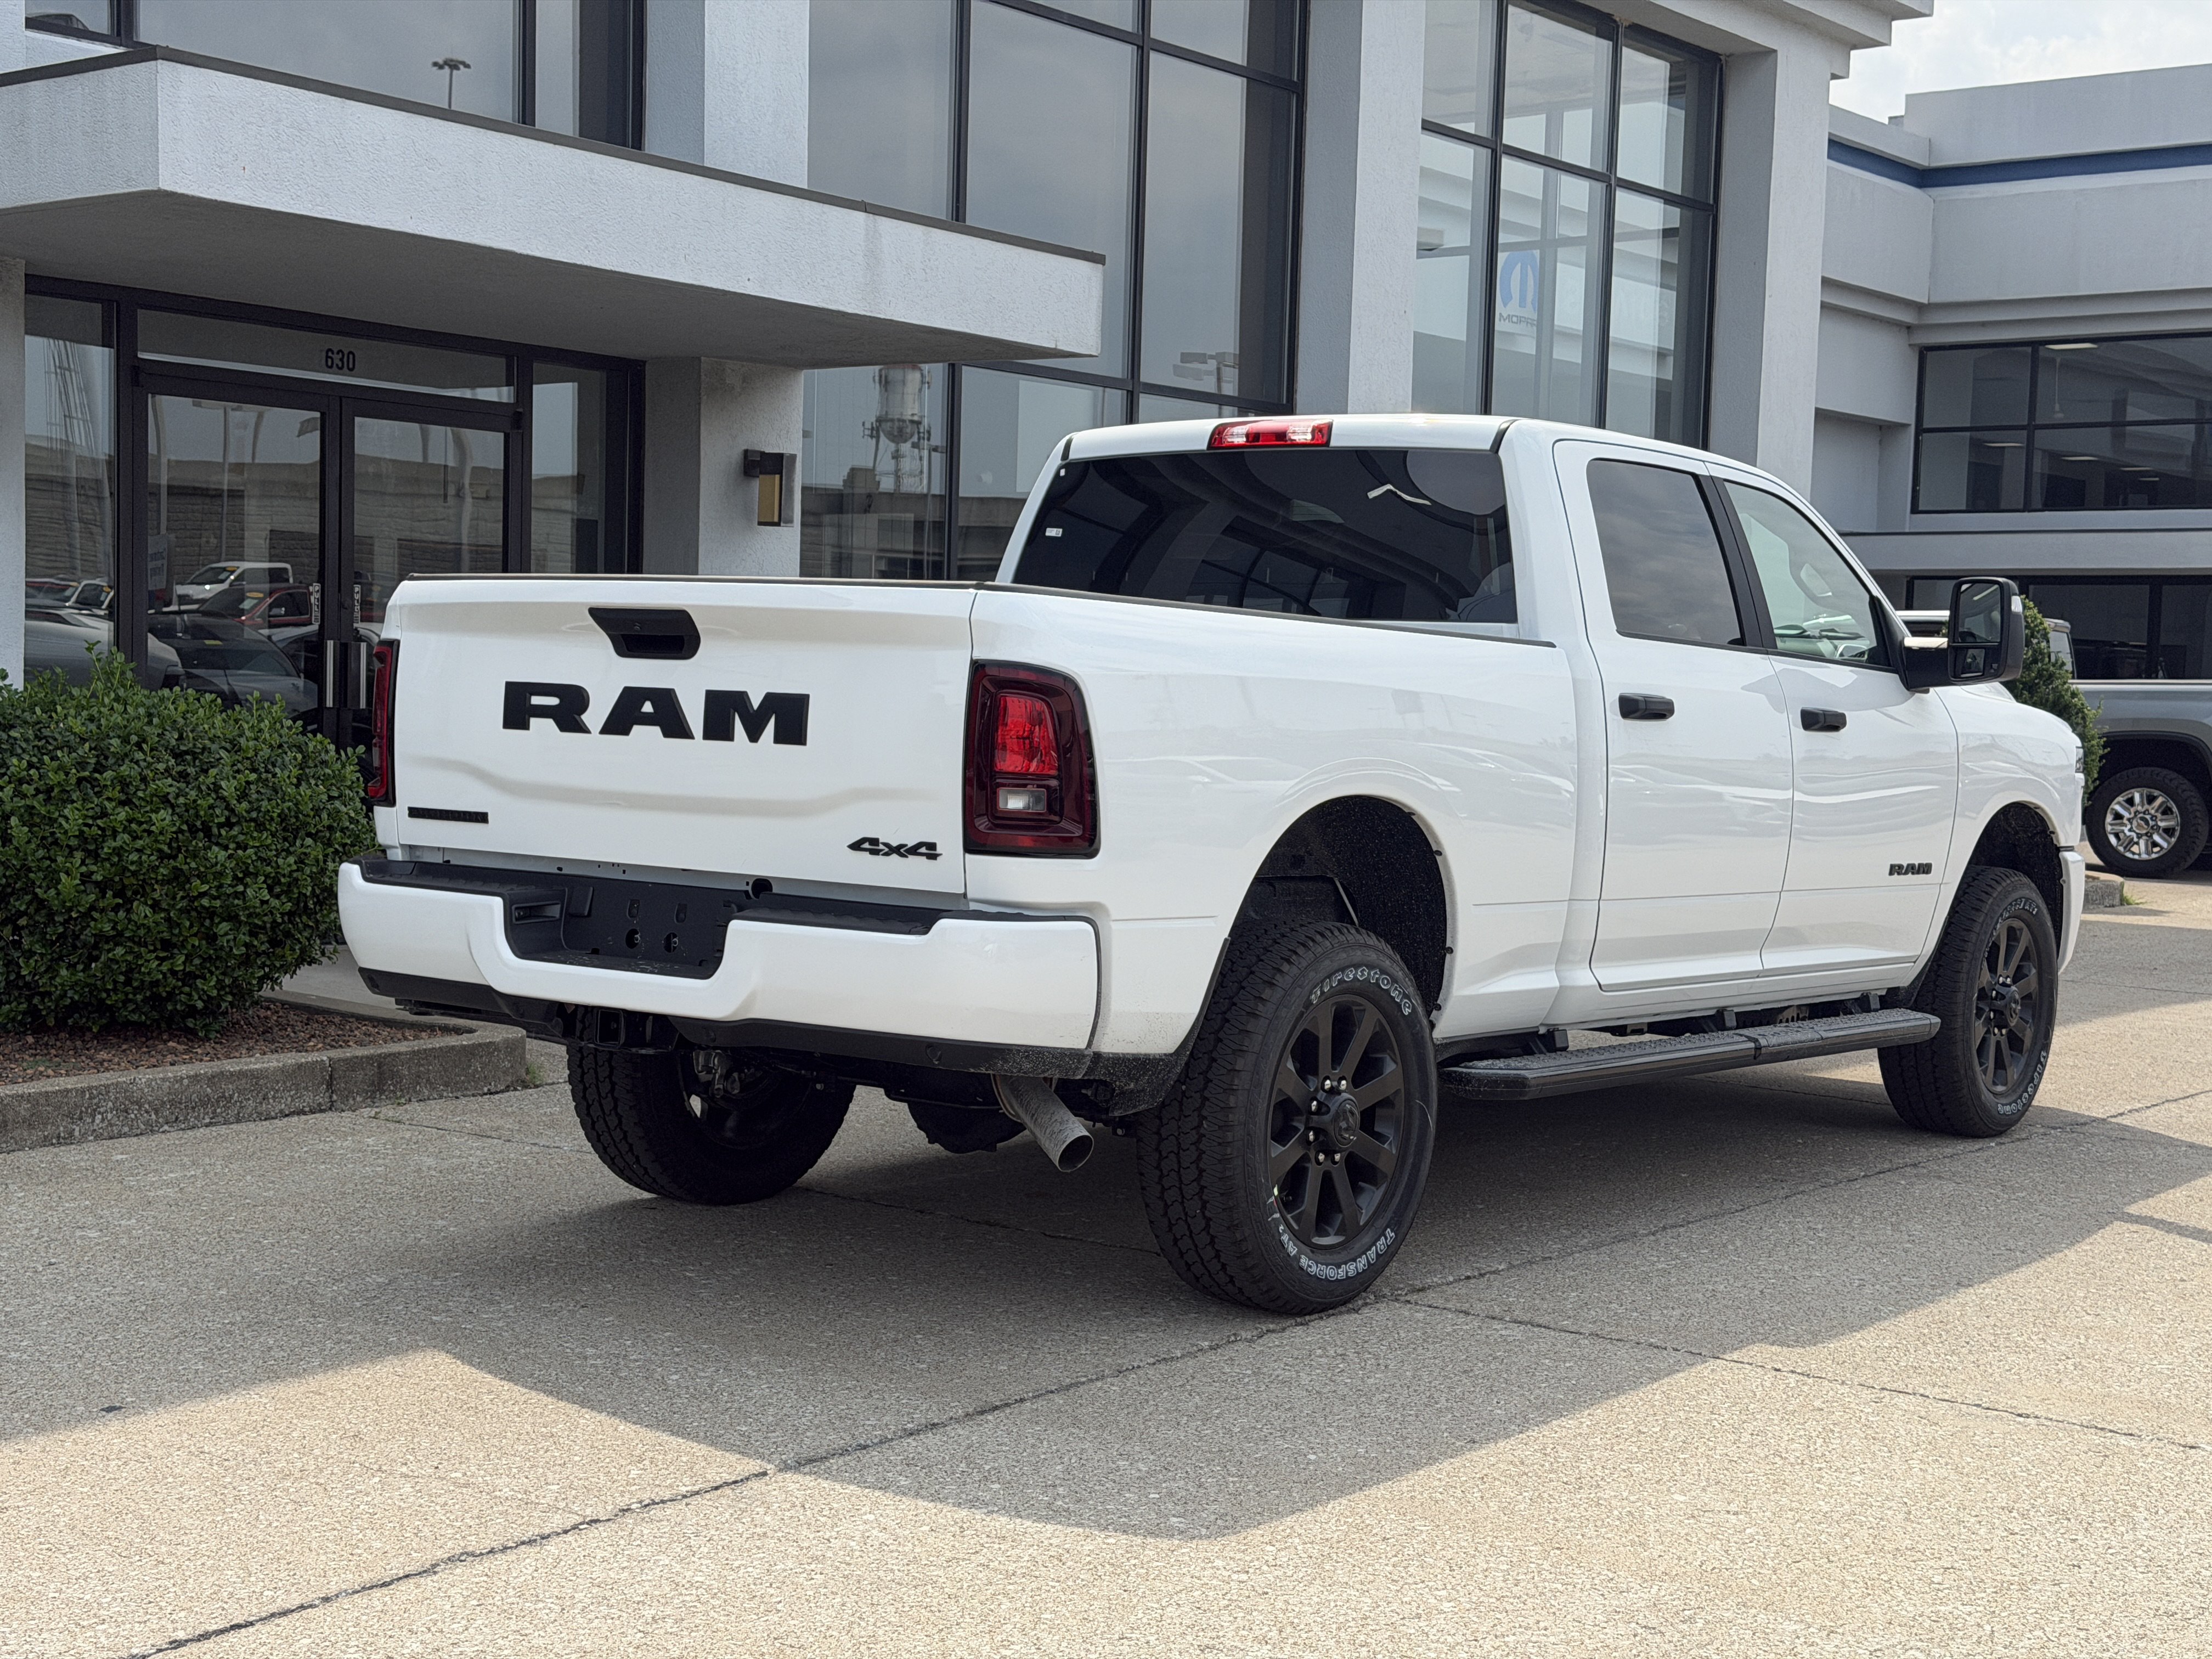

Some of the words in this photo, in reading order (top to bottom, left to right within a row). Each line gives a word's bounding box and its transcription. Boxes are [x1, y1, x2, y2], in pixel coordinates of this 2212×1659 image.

[325, 348, 356, 371] 630
[503, 681, 810, 746] RAM
[847, 837, 943, 860] 4x4
[1888, 862, 1932, 876] RAM
[1310, 967, 1412, 1015] Firestone
[1299, 1228, 1396, 1280] TRANSFORCE
